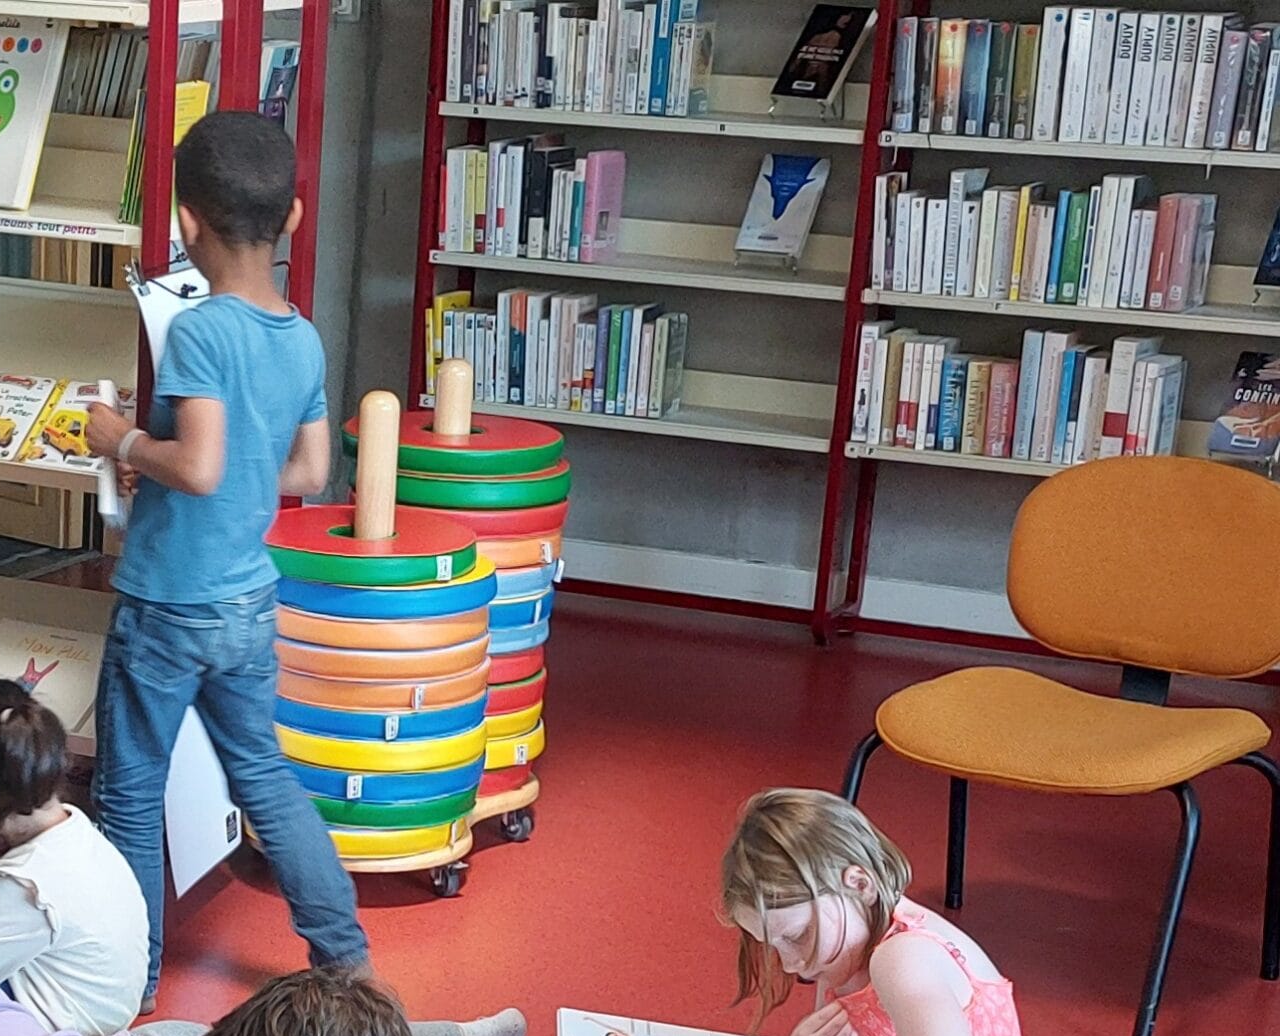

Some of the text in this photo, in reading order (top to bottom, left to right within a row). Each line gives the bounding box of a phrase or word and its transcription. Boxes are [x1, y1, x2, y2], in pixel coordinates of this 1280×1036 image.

[1120, 23, 1134, 59] DUPUY
[1141, 27, 1155, 62] DUPUY
[1161, 26, 1177, 61] DUPUY
[1183, 27, 1198, 63] DUPUY
[1204, 28, 1219, 64] DUPUY
[885, 135, 892, 143] D
[36, 221, 62, 232] tout
[62, 224, 97, 236] petits
[967, 380, 980, 418] FOLLETT
[24, 638, 55, 655] MON
